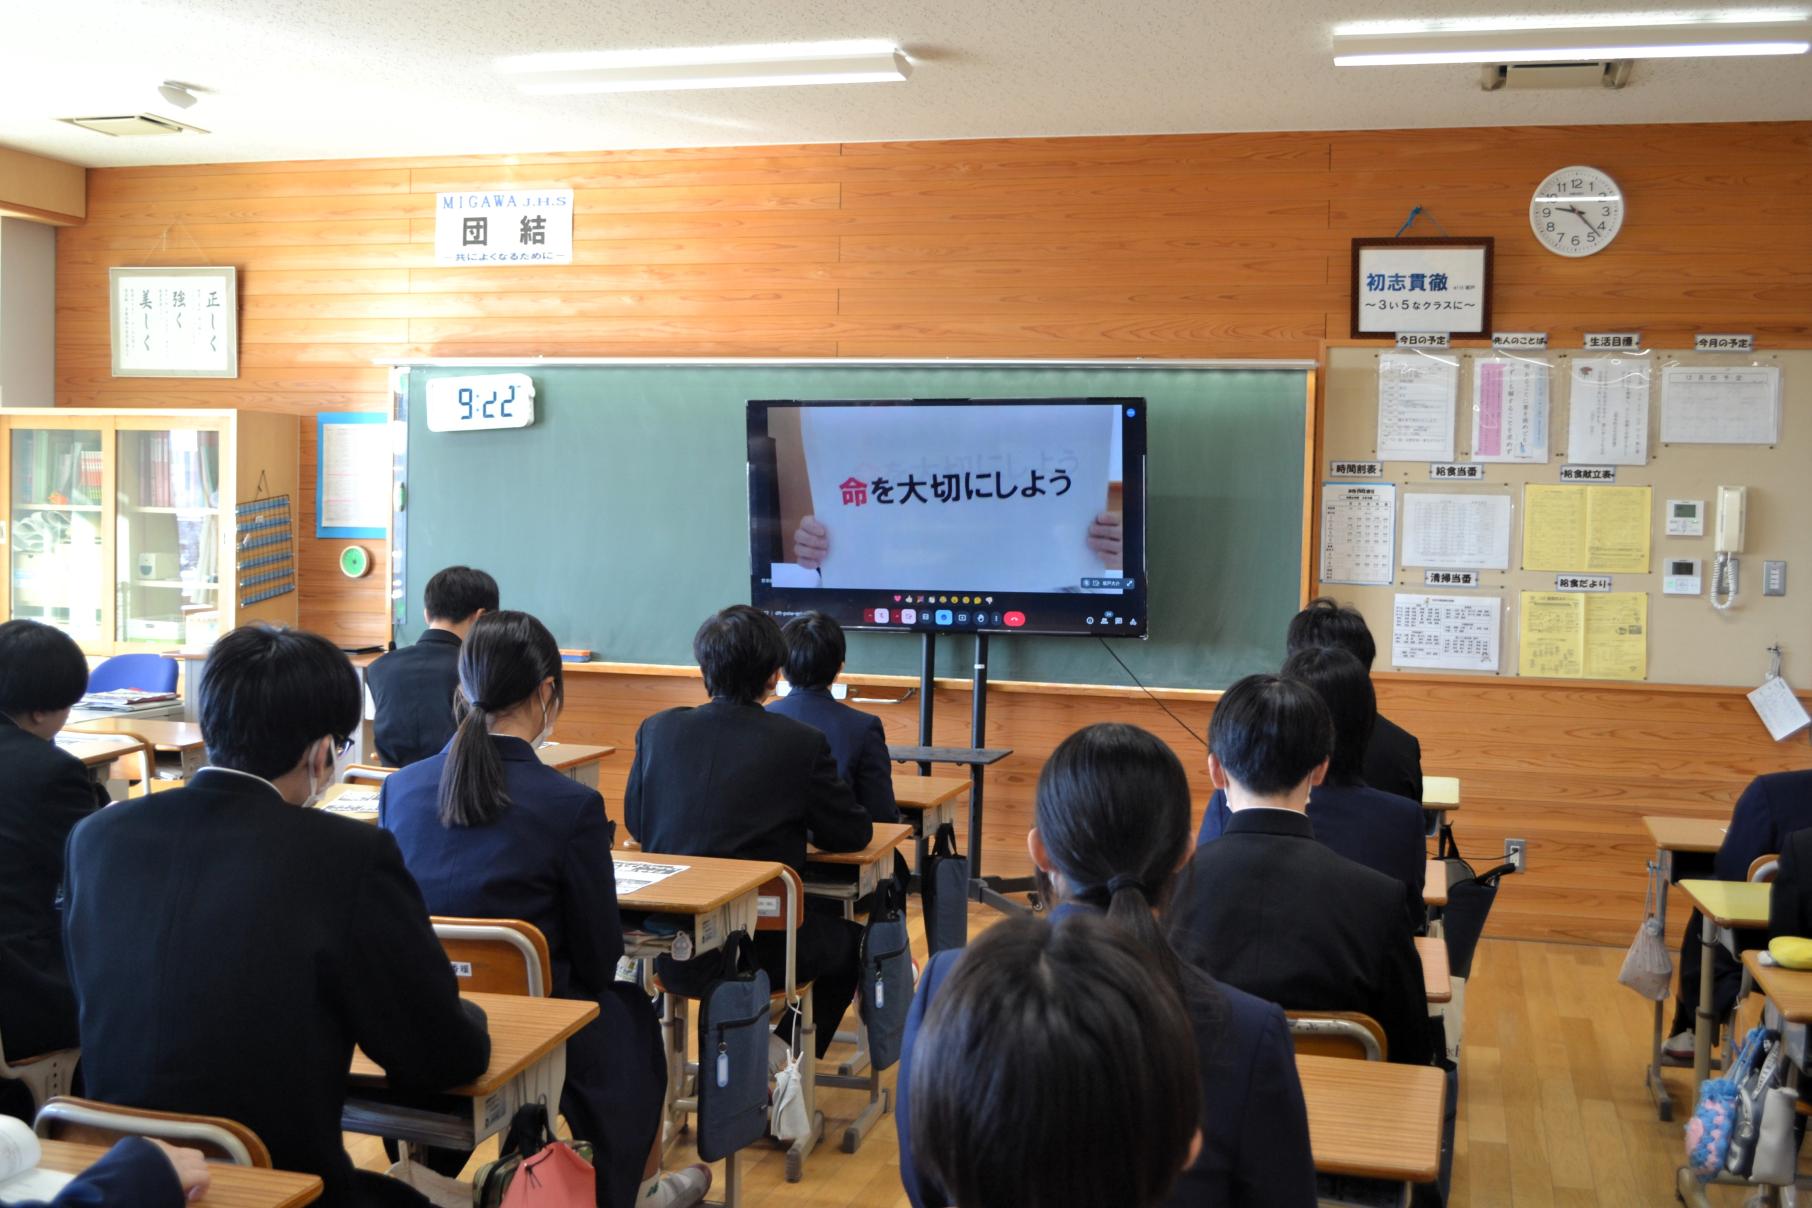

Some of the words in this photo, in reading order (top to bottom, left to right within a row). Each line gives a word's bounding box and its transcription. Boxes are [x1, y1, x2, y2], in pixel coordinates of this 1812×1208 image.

[1557, 183, 1566, 192] 11
[1571, 179, 1583, 189] 12
[443, 195, 517, 209] MIGAWA
[1542, 208, 1551, 217] 9
[1601, 207, 1610, 217] 3
[1546, 222, 1555, 232] 8
[1597, 221, 1606, 230] 4
[1557, 233, 1565, 242] 7
[1571, 235, 1580, 246] 6
[1587, 232, 1595, 242] 5
[1366, 273, 1448, 292] 初志貫徹
[172, 290, 186, 329] 強く
[139, 289, 152, 352] 美しく
[206, 291, 220, 352] 正しく
[1399, 335, 1446, 345] 今日の予定
[1493, 336, 1546, 345] 先人のことば
[1590, 336, 1633, 347] 生活目標
[1699, 338, 1749, 348] 今月の予定
[459, 385, 515, 420] 9:22
[1335, 464, 1377, 474] 時間割表
[1436, 466, 1477, 477] 給食当番
[1564, 469, 1611, 479] 給食献立表
[839, 468, 1072, 506] 命を大切にしよう
[1430, 572, 1472, 584] 清掃当番
[1560, 578, 1606, 588] 給食だより
